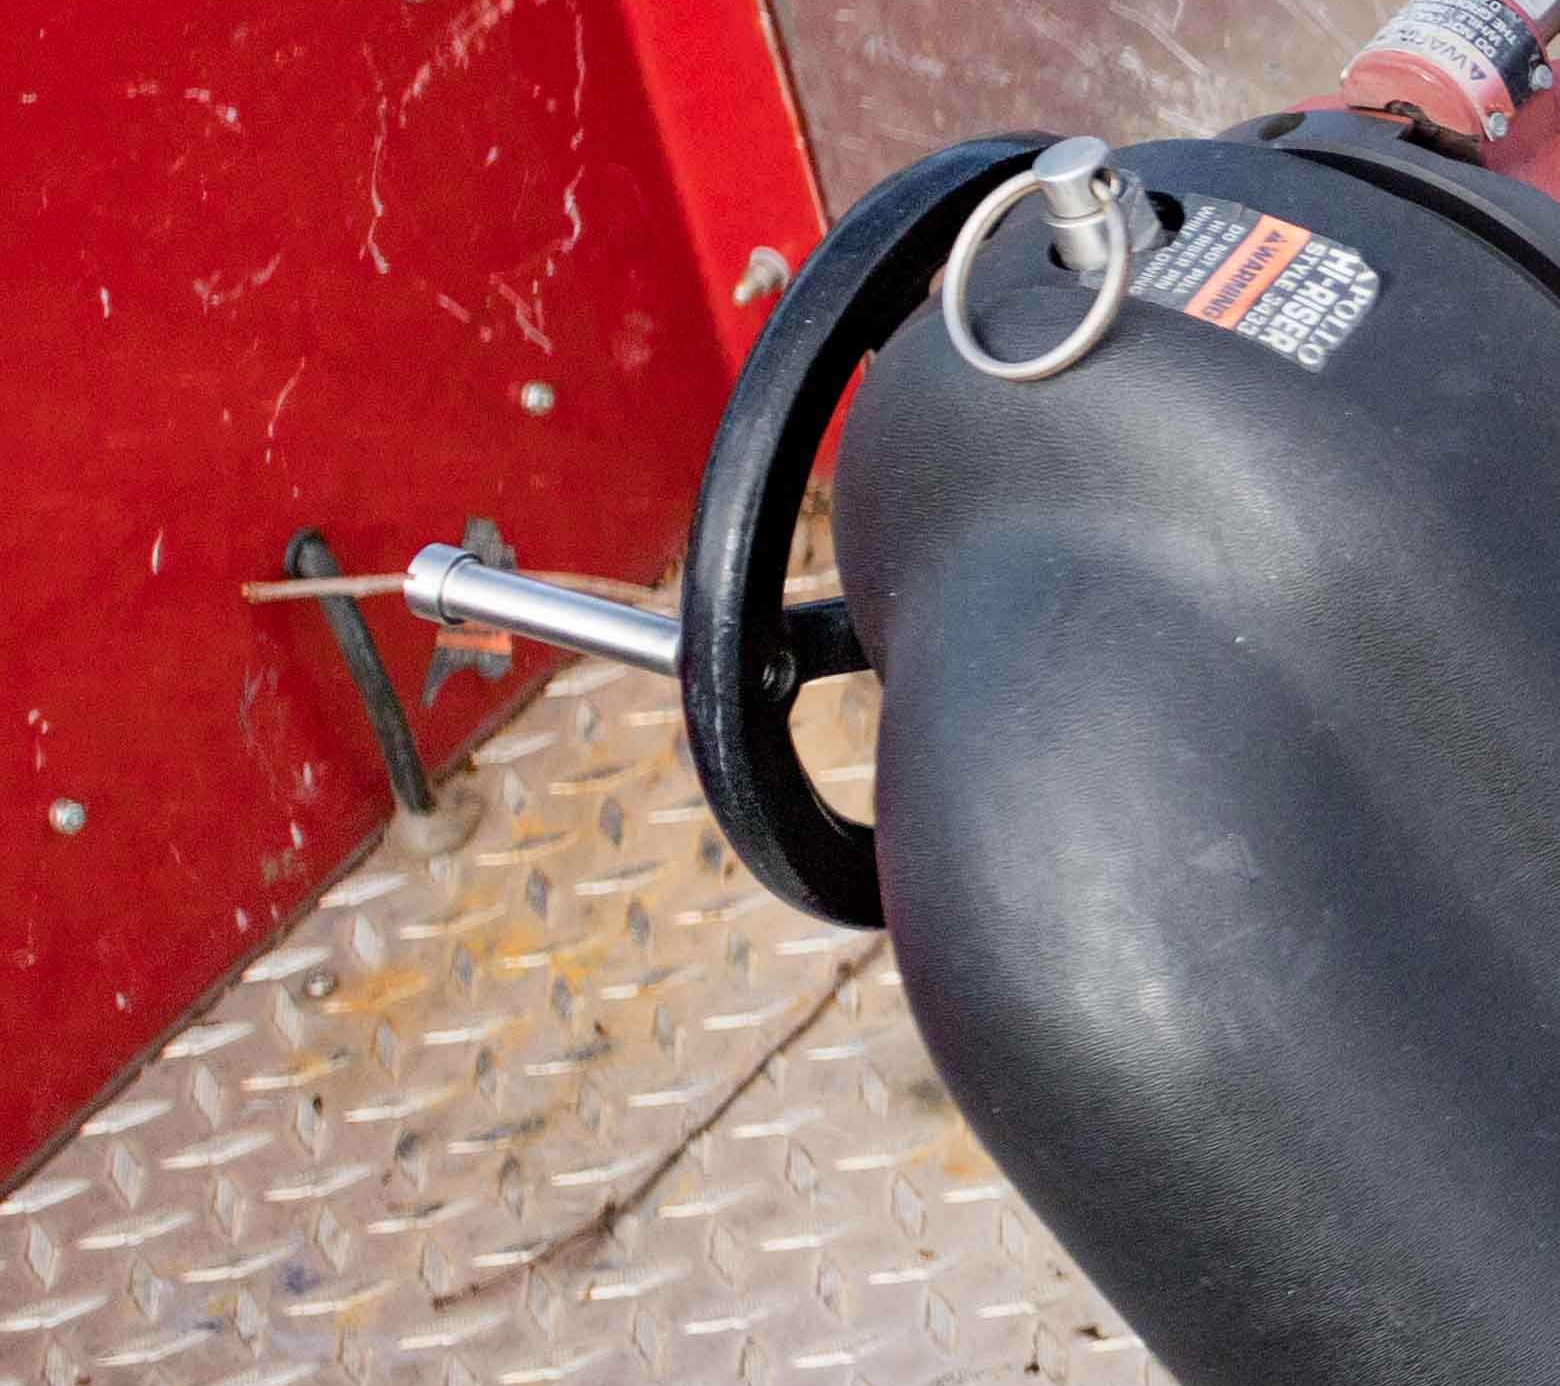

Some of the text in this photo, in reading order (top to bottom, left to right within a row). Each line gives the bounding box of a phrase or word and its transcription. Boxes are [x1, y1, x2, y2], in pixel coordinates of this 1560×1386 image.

[1152, 269, 1181, 291] PIN
[1173, 223, 1245, 294] DO NOT PULL
[1200, 247, 1275, 322] WARNING
[1236, 241, 1327, 336] STYLE 3433
[1258, 248, 1361, 354] HI-RISER
[1296, 270, 1378, 365] APOLLO
